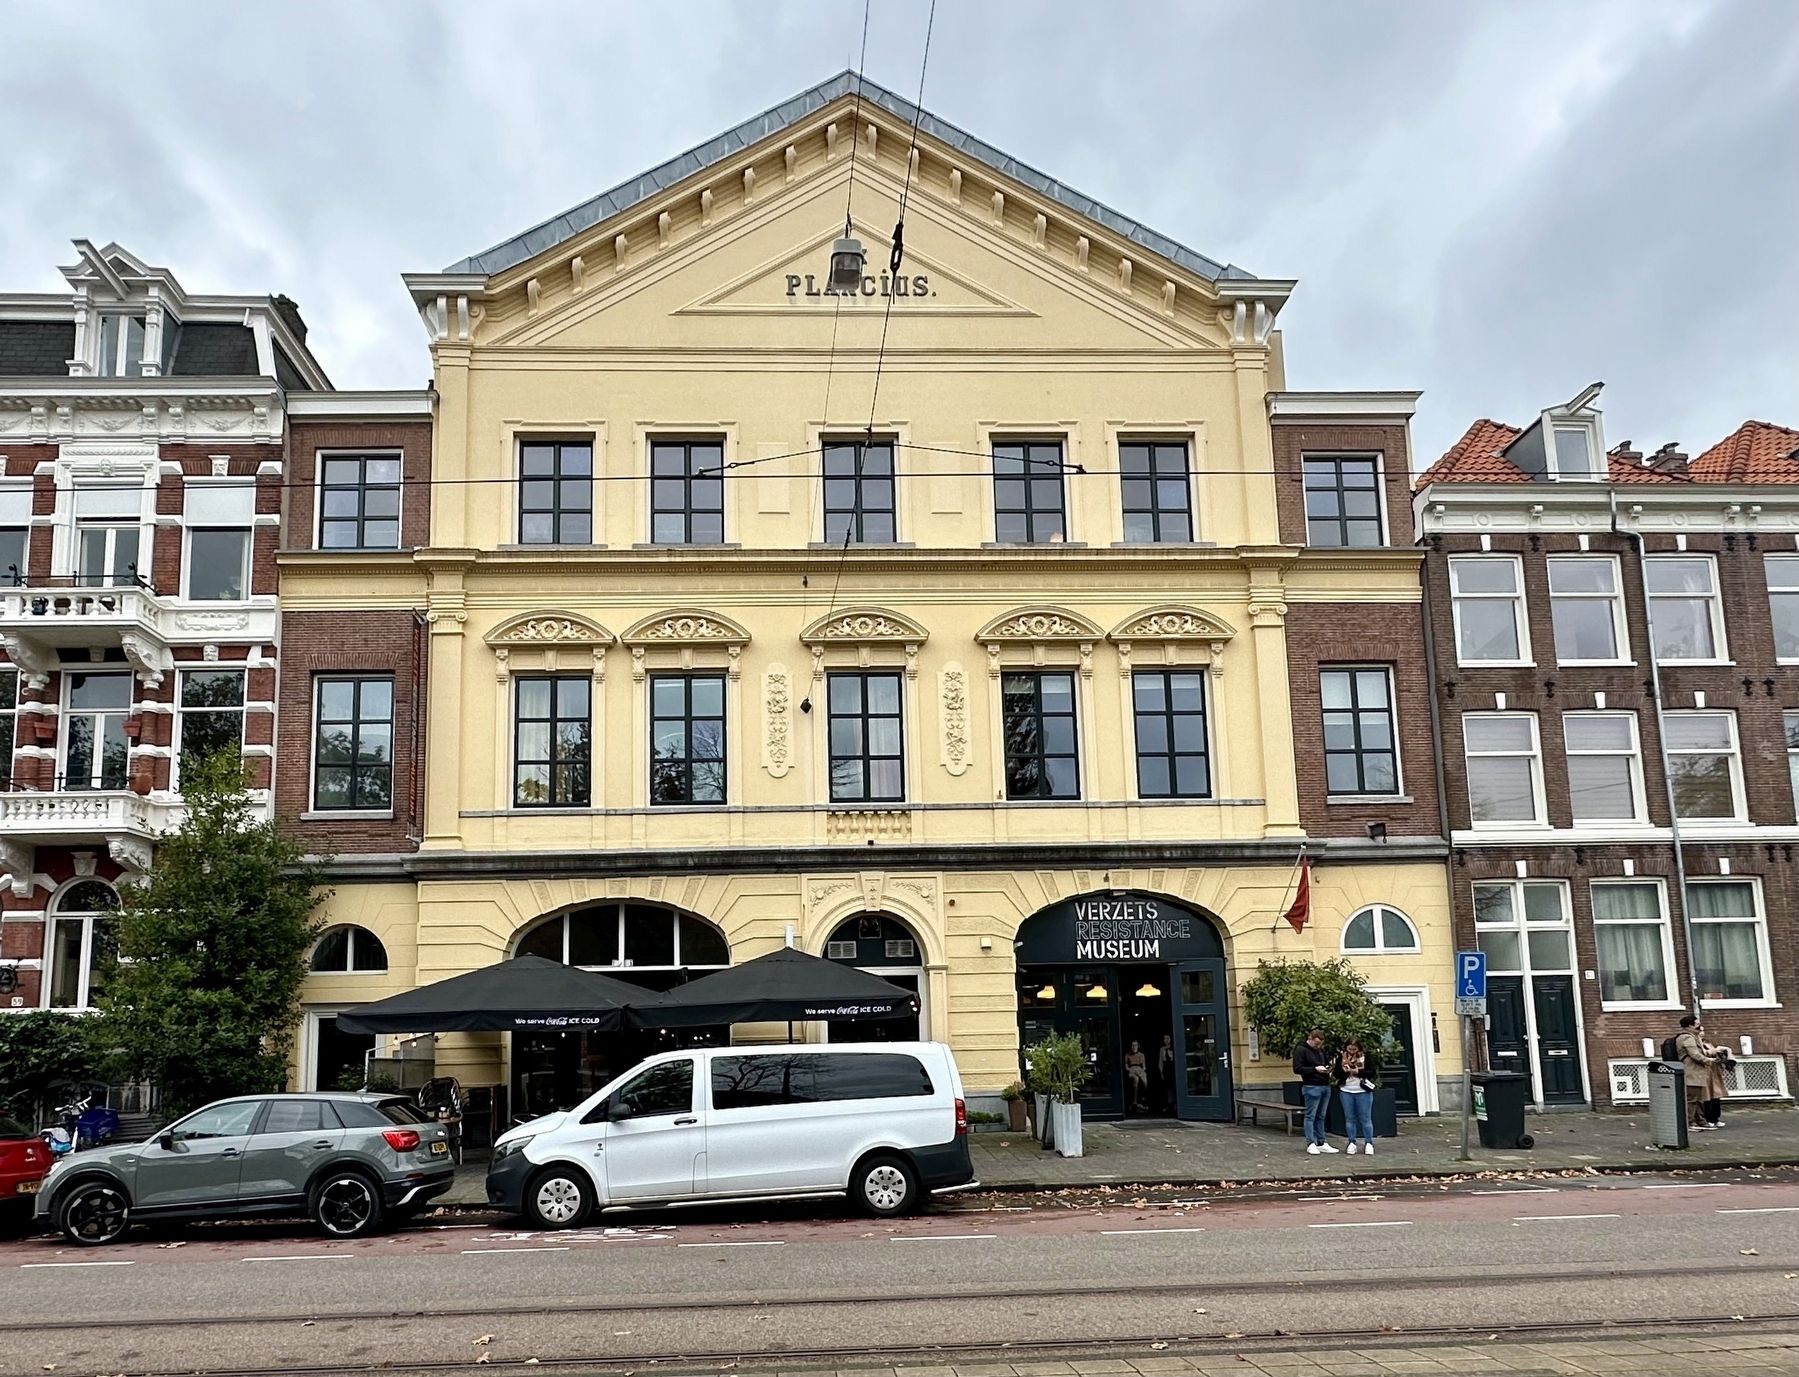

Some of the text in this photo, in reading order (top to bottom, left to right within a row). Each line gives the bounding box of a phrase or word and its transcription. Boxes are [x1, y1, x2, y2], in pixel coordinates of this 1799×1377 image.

[1074, 902, 1158, 920] VERZETS
[1075, 920, 1191, 940] RESISTANCE
[1076, 940, 1160, 959] MUSEUM
[1463, 956, 1480, 979] P
